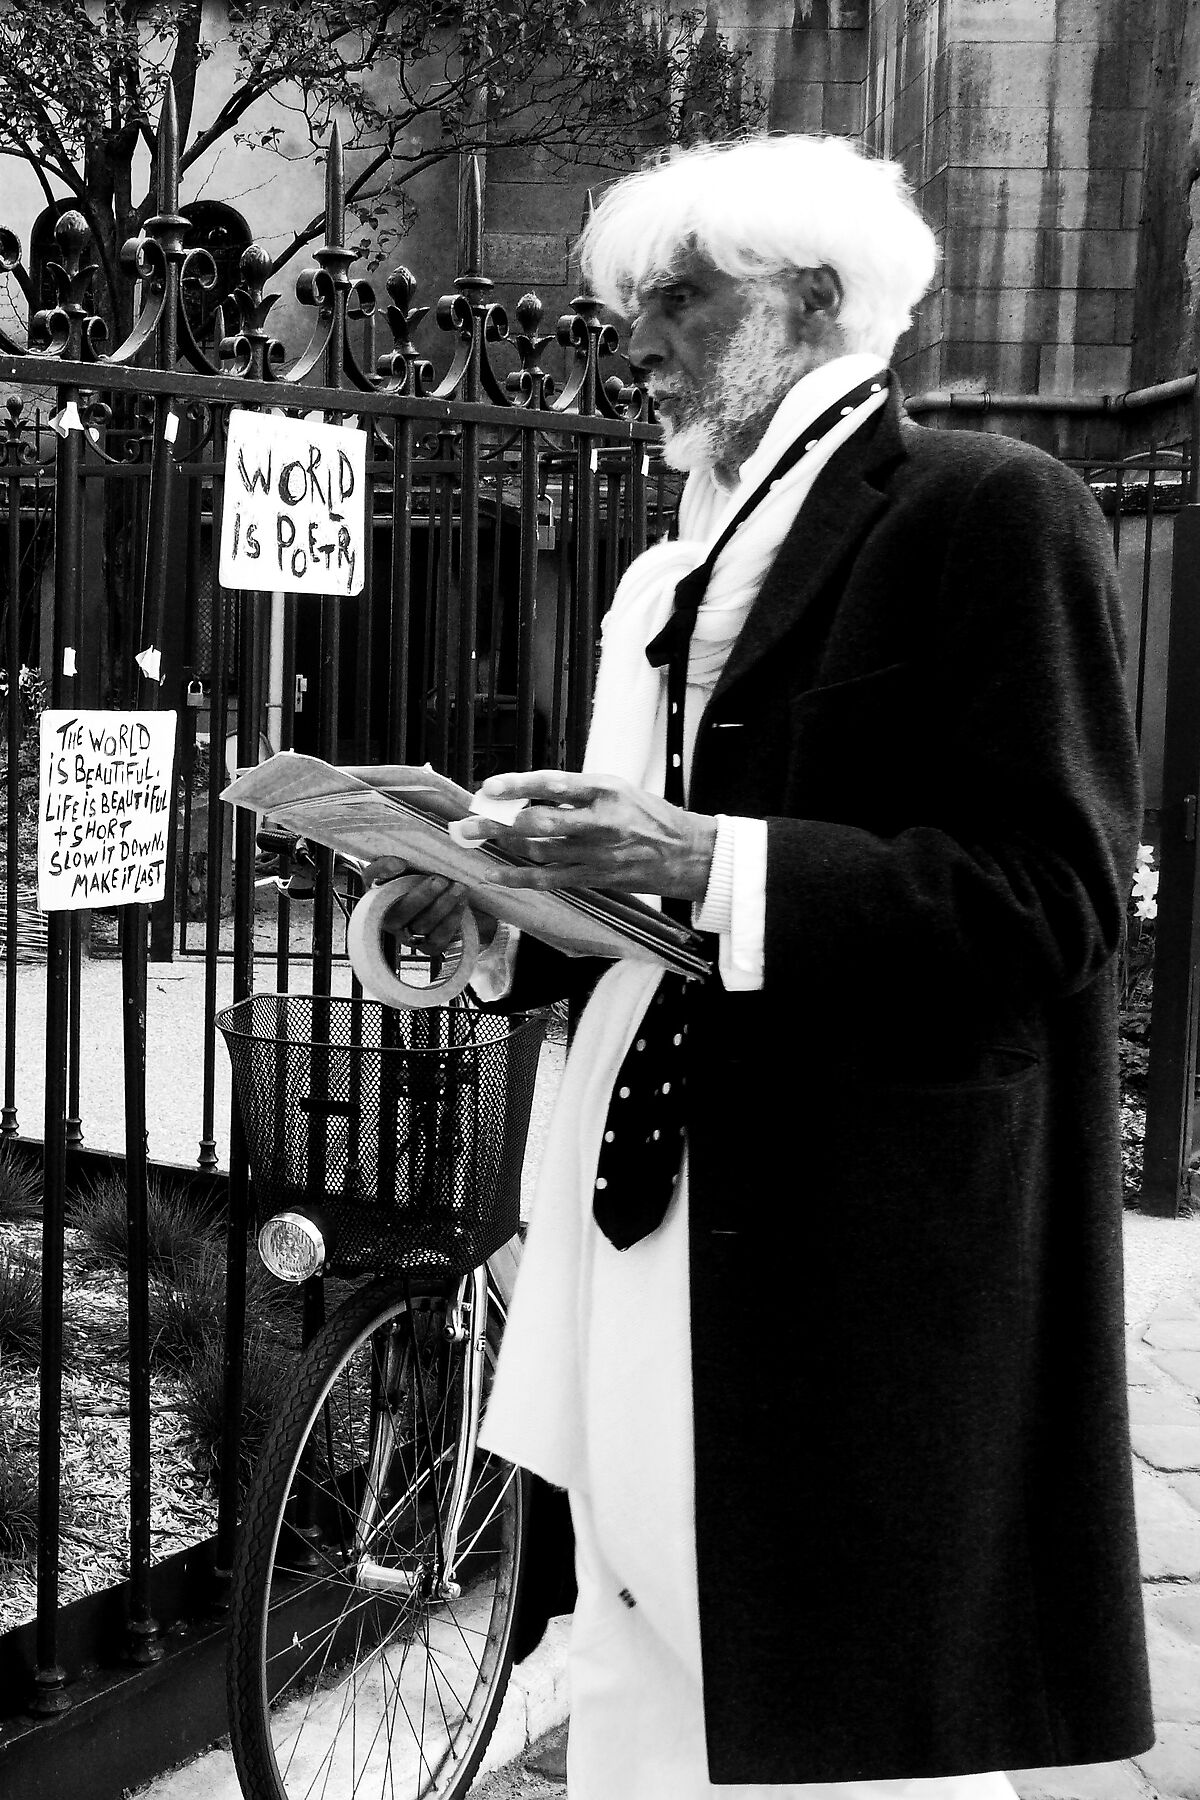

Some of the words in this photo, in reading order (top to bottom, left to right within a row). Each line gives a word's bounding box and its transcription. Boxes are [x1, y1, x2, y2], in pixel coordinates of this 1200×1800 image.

[236, 444, 355, 522] WORLD
[277, 512, 355, 594] POETRY
[56, 718, 84, 751] THE
[89, 722, 151, 757] WORLD
[70, 818, 133, 848] SHORT
[49, 850, 98, 876] SLOW
[71, 868, 118, 898] MAKE
[134, 860, 165, 894] LAST
